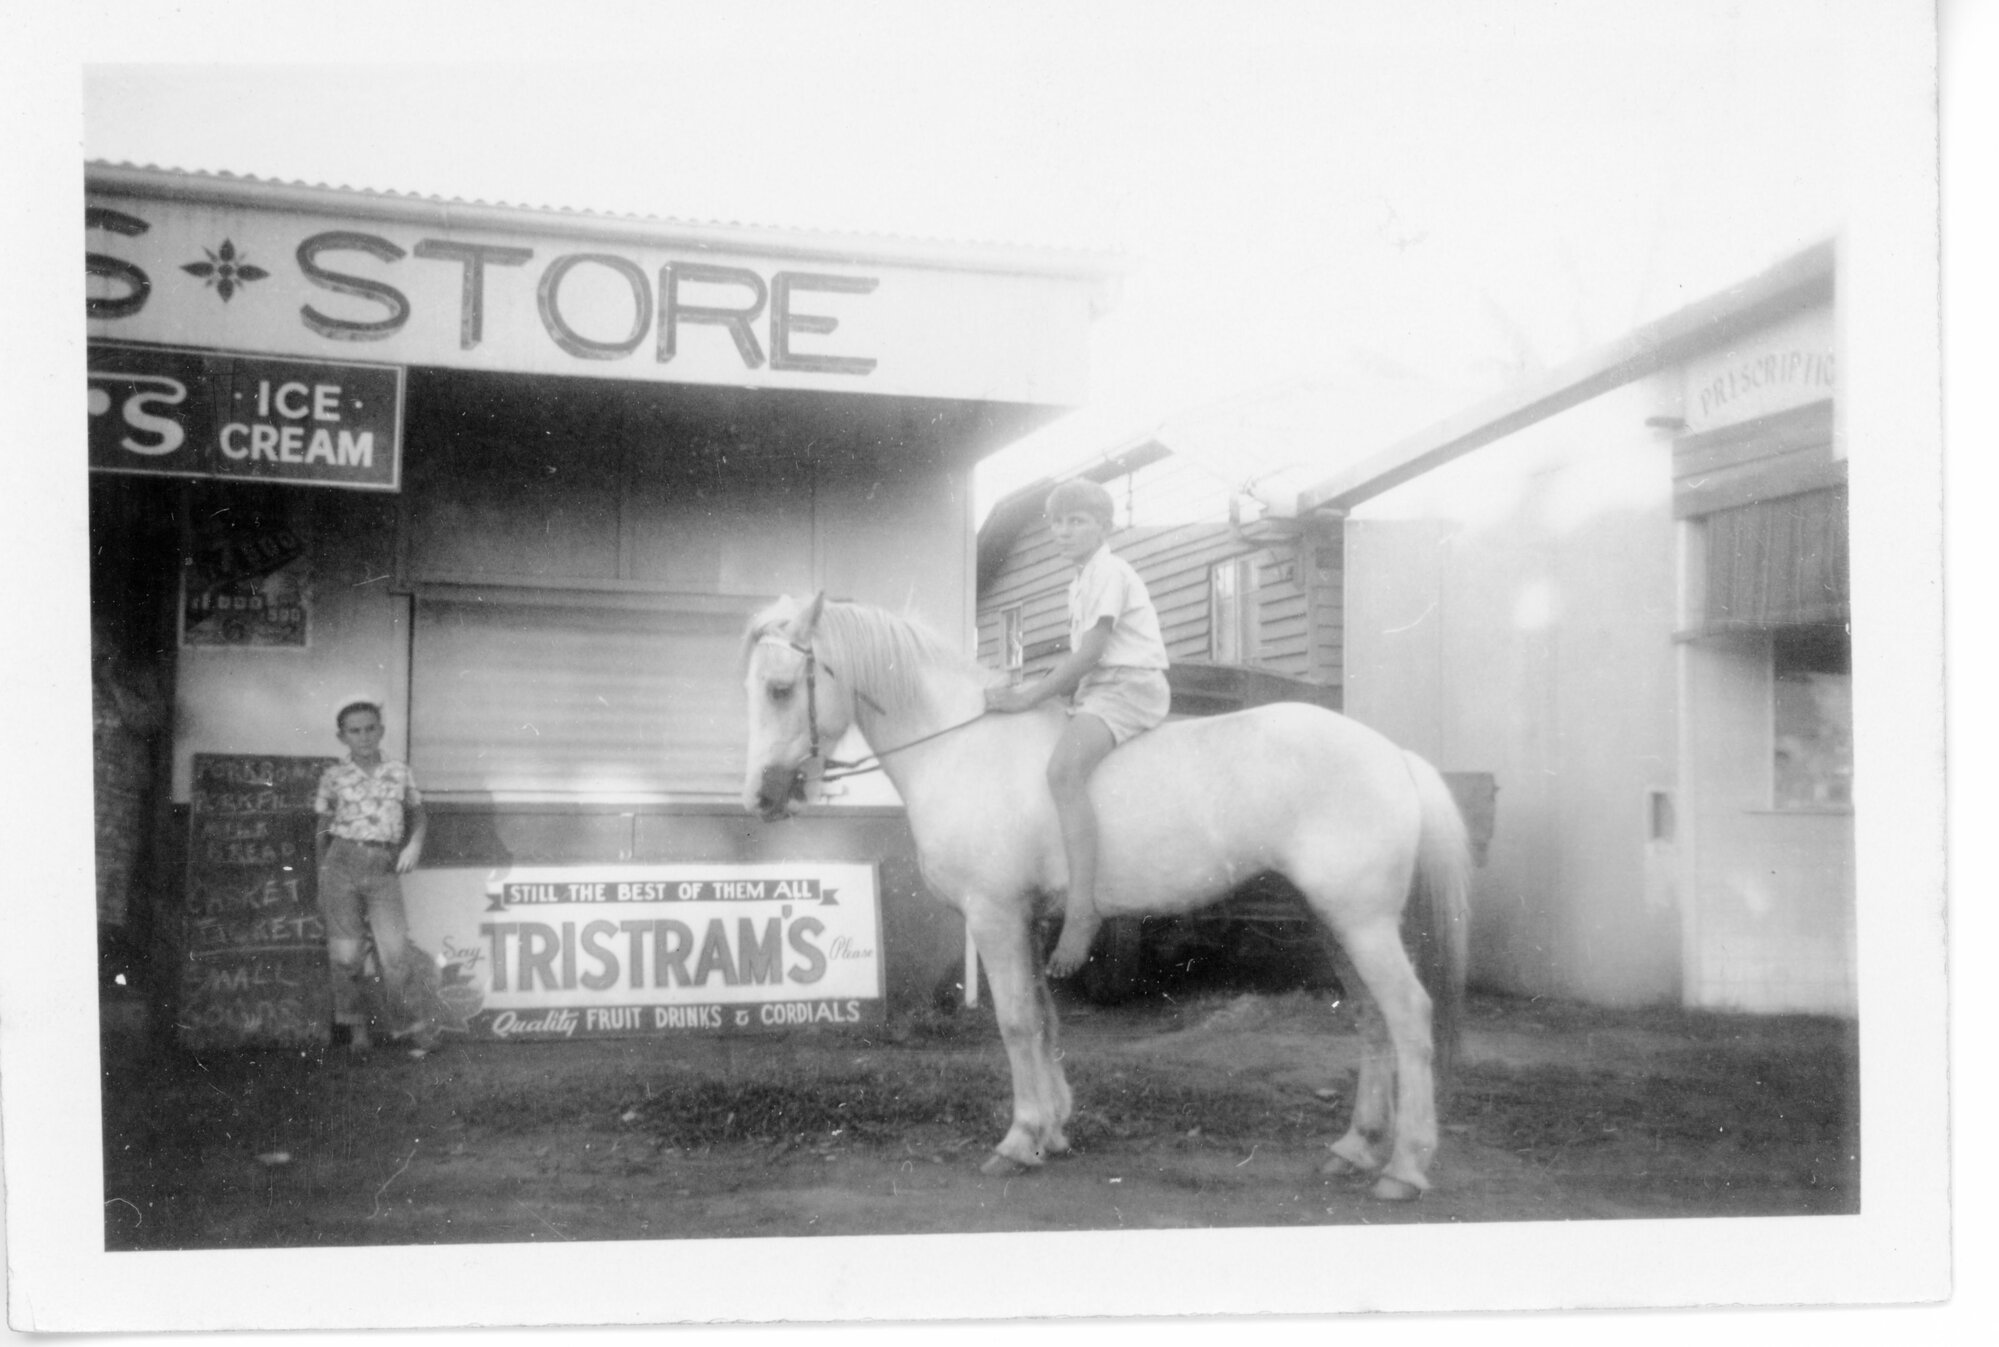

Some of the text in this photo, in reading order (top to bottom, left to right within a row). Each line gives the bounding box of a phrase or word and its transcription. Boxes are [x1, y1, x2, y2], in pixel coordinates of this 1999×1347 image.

[295, 229, 880, 377] STORE
[257, 380, 342, 422] ICE
[219, 422, 374, 467] CREAM
[510, 879, 812, 902] STILL THE BEST OF THEM ALL
[442, 904, 874, 992] Say TRISTRAM'S Please
[492, 1010, 580, 1037] Quality
[586, 1006, 641, 1030] FRUIT
[655, 1005, 722, 1028] DRINKS
[760, 1000, 861, 1025] CORDIALS
